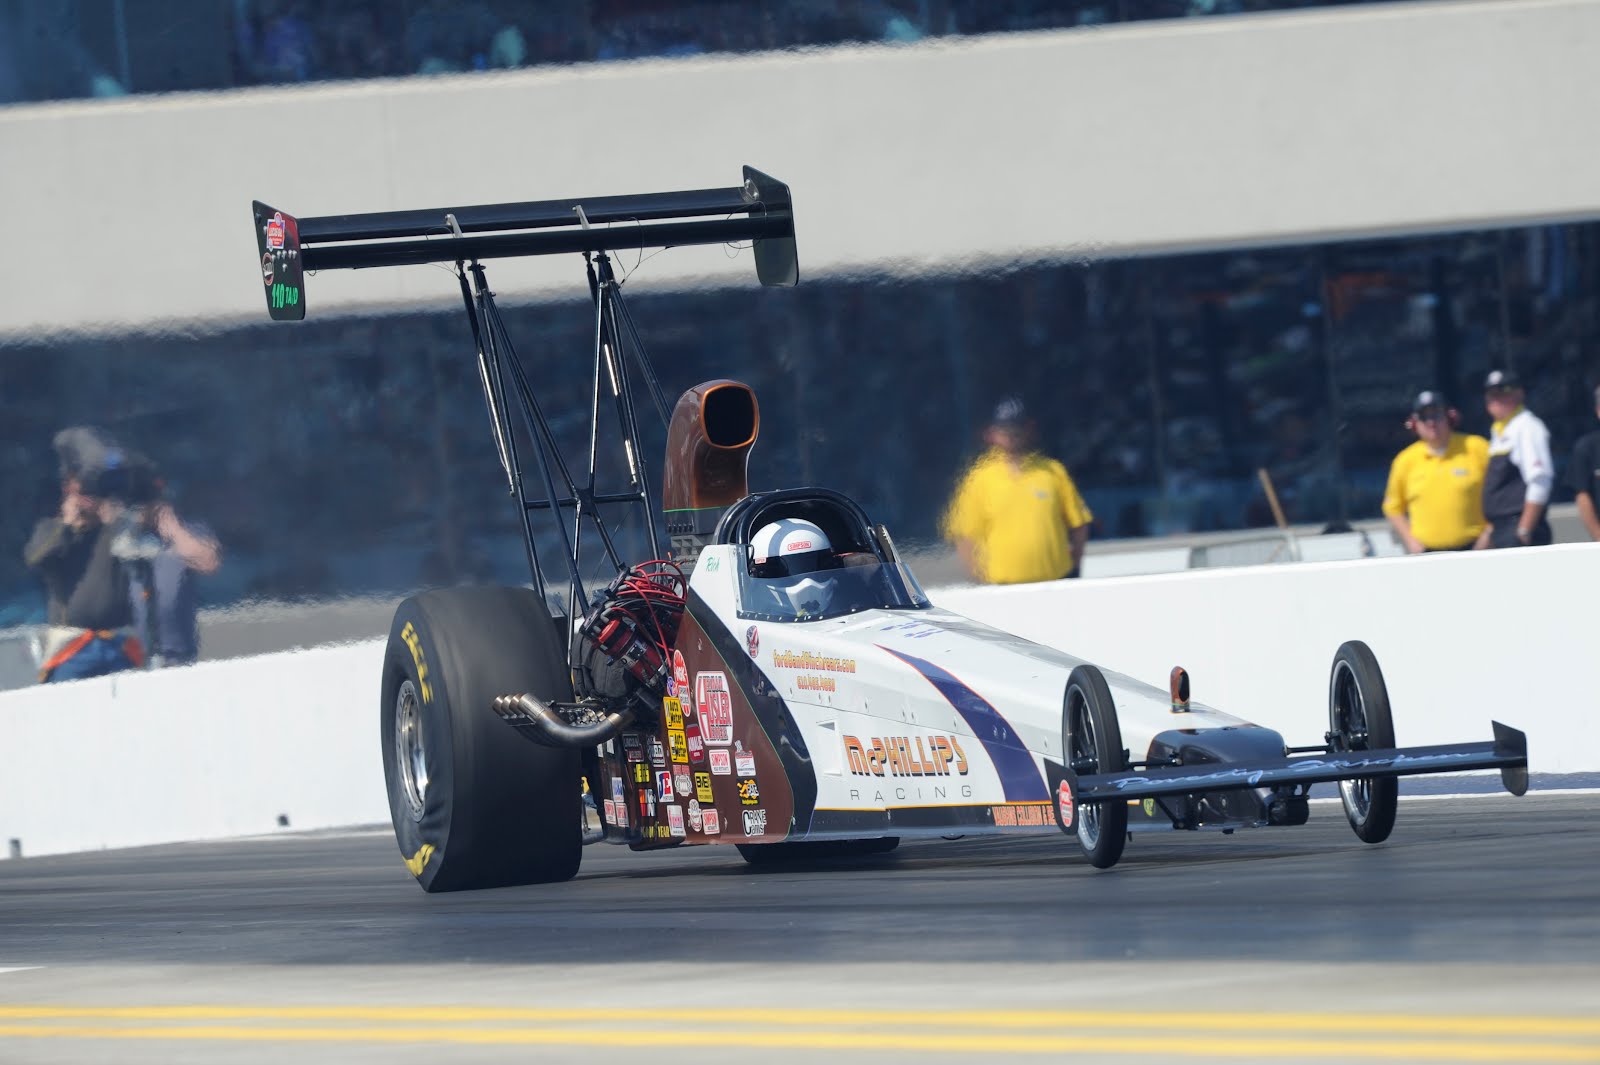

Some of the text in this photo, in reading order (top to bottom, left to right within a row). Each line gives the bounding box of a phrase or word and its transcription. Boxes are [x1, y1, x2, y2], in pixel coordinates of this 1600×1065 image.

[272, 283, 285, 308] 110
[788, 541, 811, 550] SIMPSON
[711, 753, 729, 766] SIMPSON
[850, 785, 972, 801] RACING
